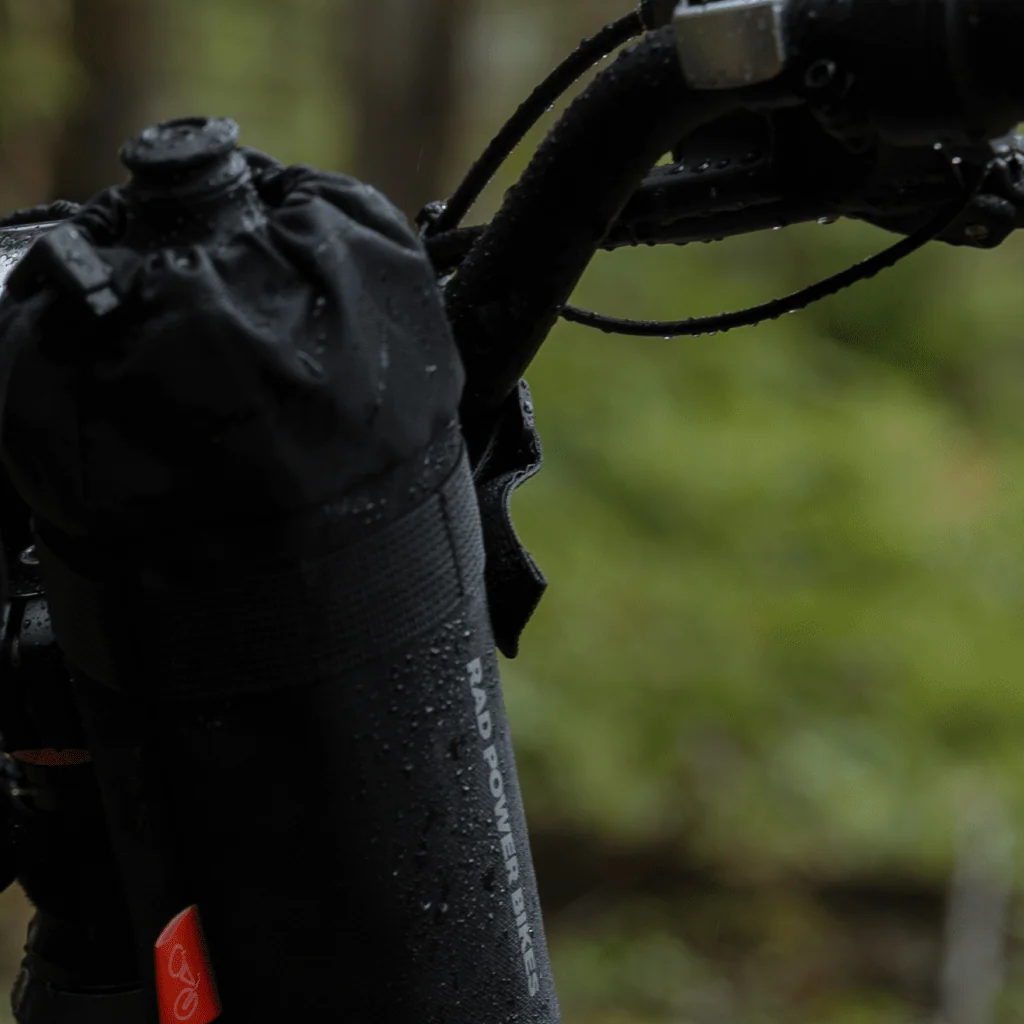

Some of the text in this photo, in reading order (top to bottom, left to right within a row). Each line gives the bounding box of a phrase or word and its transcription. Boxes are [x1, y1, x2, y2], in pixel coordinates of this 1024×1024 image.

[466, 657, 539, 997] RAD POWER BIKES
